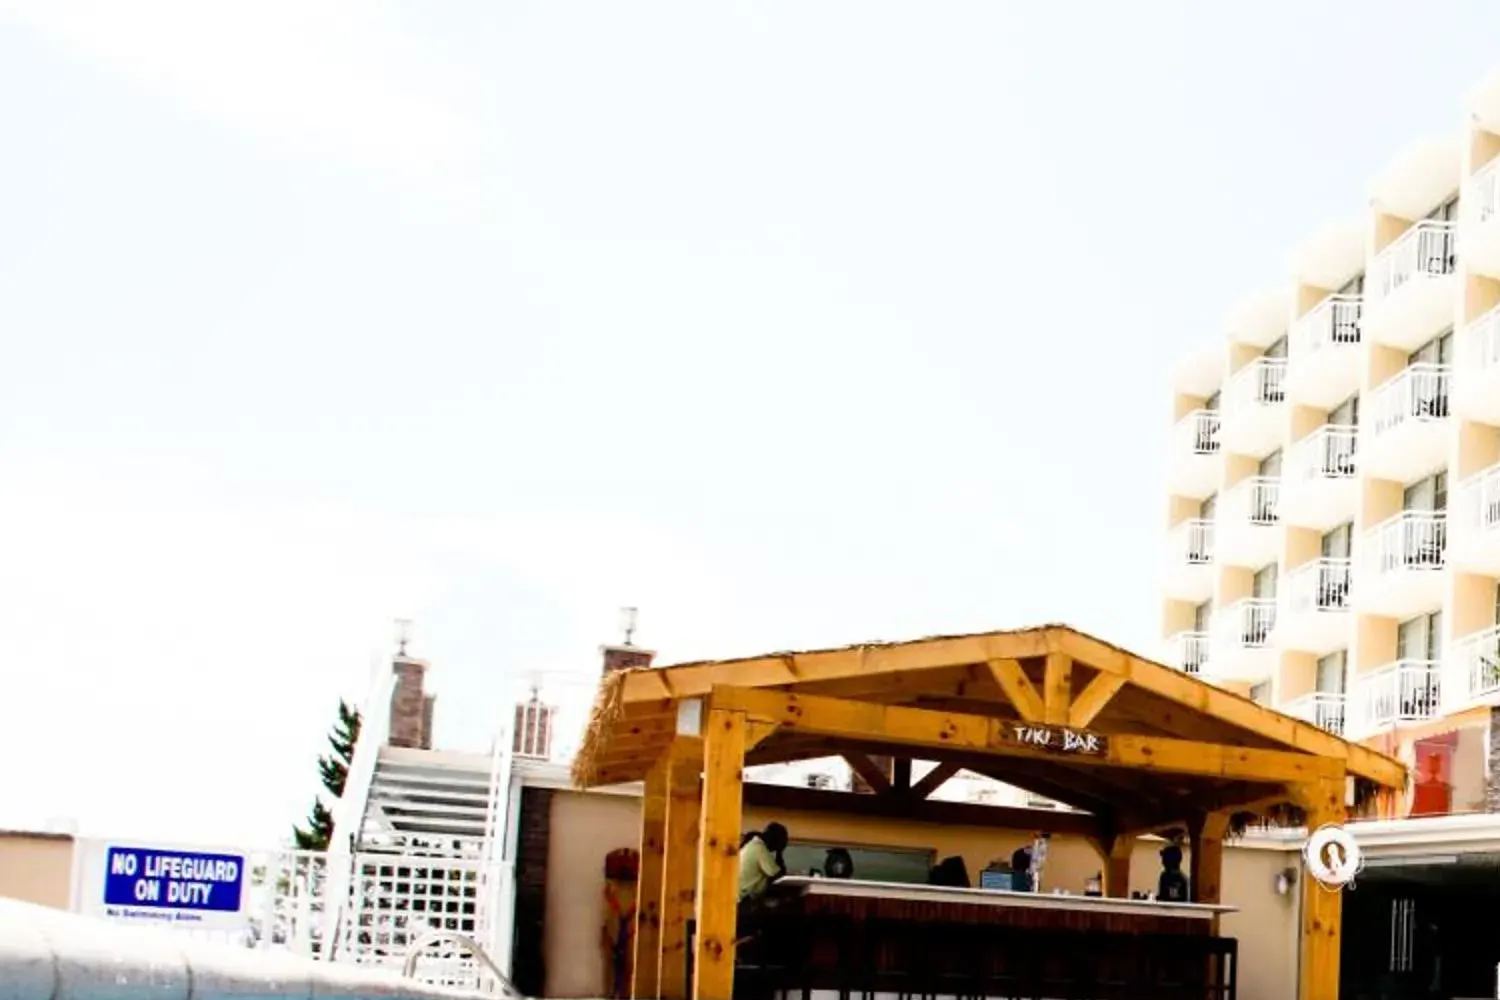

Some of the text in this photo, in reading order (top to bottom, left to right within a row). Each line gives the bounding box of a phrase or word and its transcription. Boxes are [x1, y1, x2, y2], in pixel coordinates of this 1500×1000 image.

[1014, 727, 1099, 751] TIKI BAR
[111, 852, 239, 883] NO LIFEGUARD
[134, 878, 213, 904] ON DUTY
